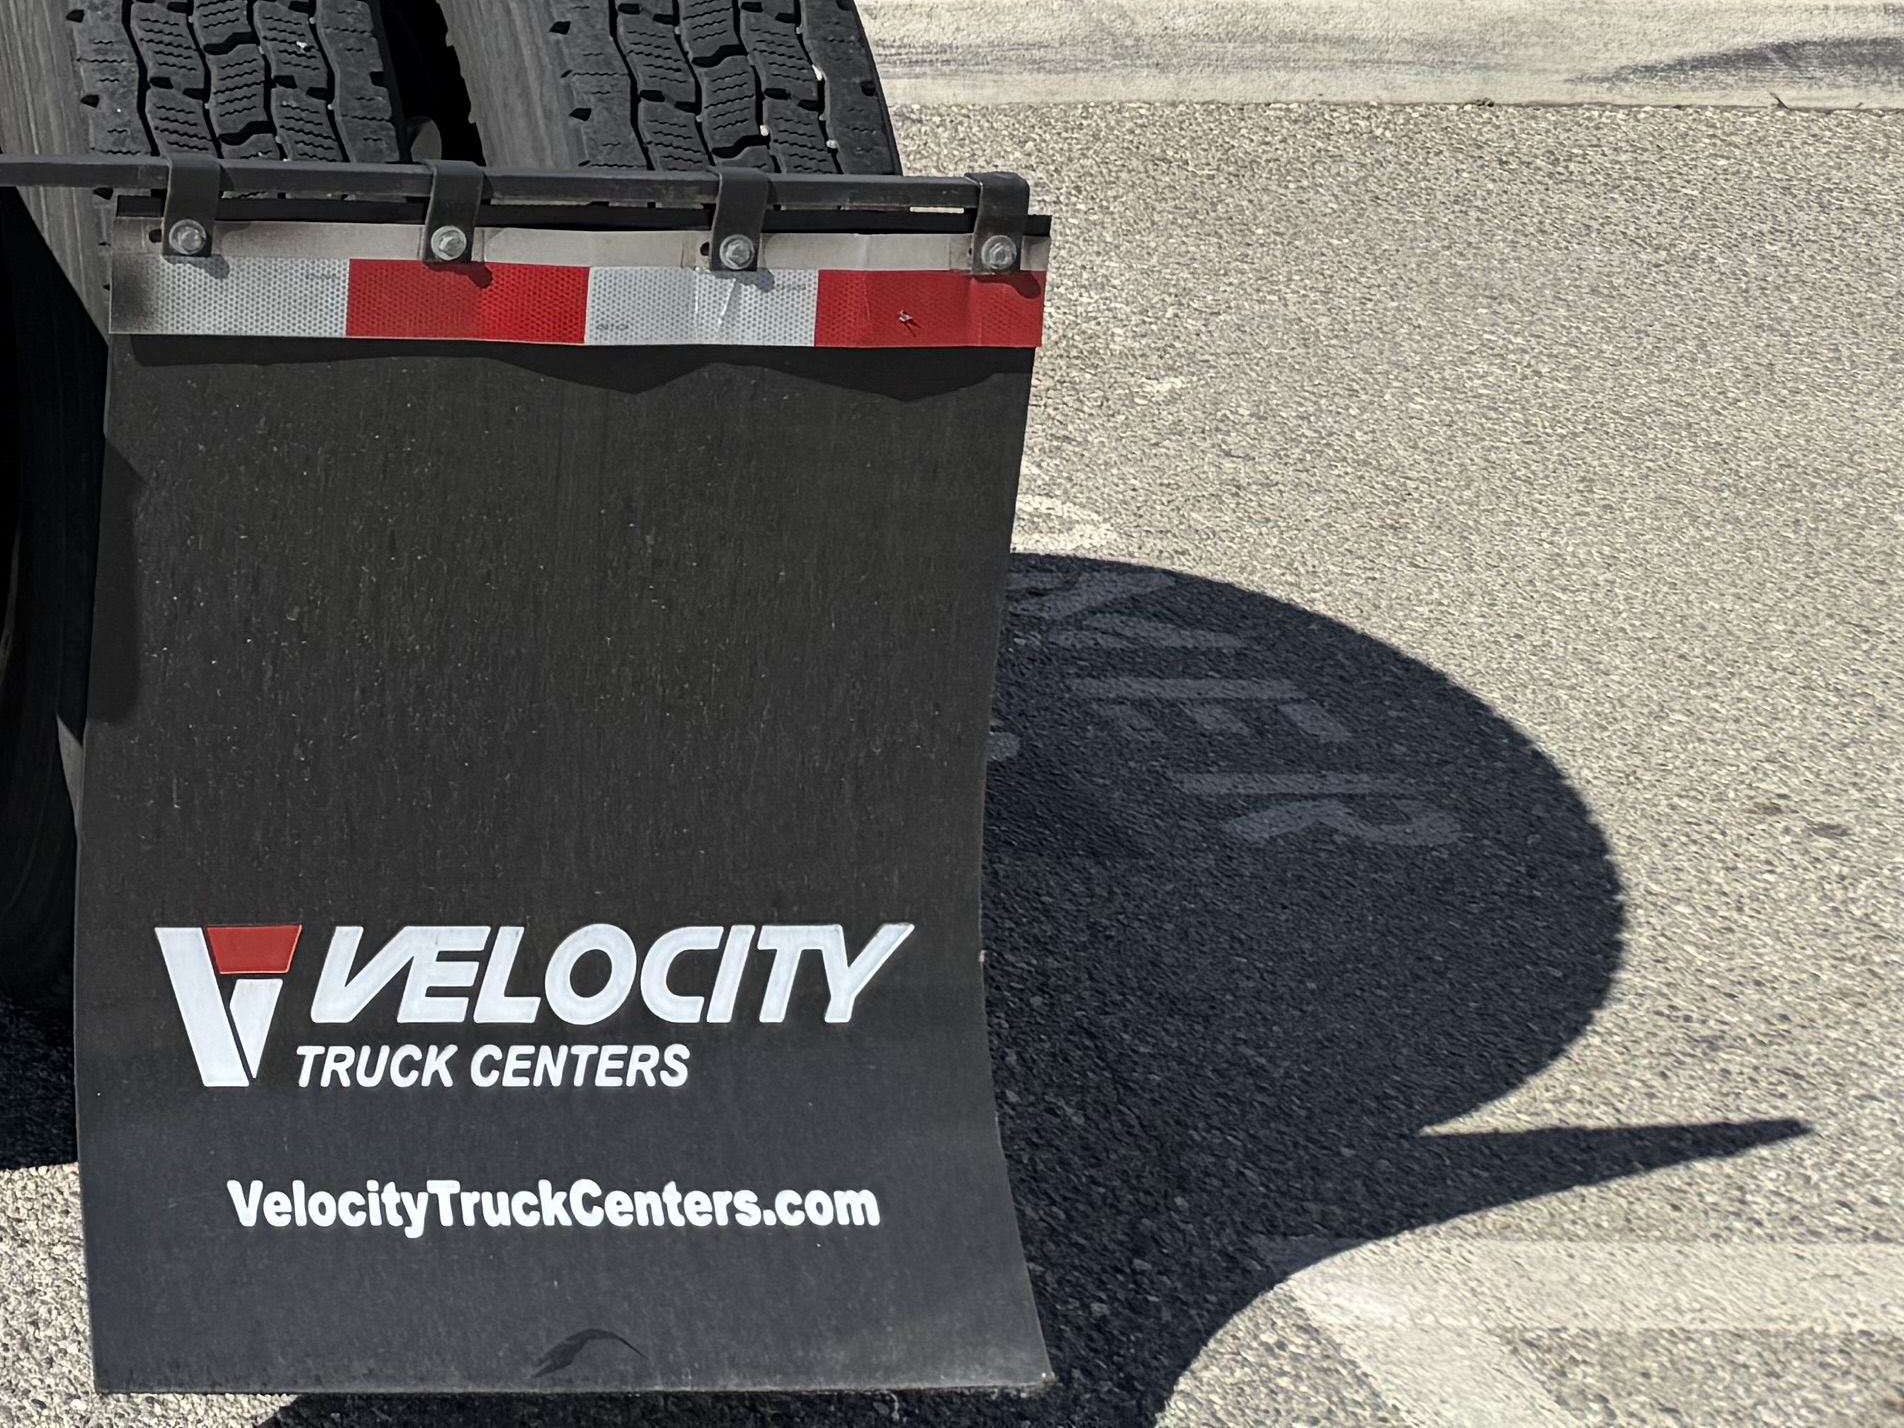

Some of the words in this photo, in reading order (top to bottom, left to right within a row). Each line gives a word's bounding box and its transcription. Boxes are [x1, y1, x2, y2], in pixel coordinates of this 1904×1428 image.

[310, 922, 916, 1026] VELOCITY
[295, 1043, 459, 1088] TRUCK
[470, 1043, 691, 1088] CENTERS
[226, 1178, 881, 1239] VelocityTruckCenters.com
